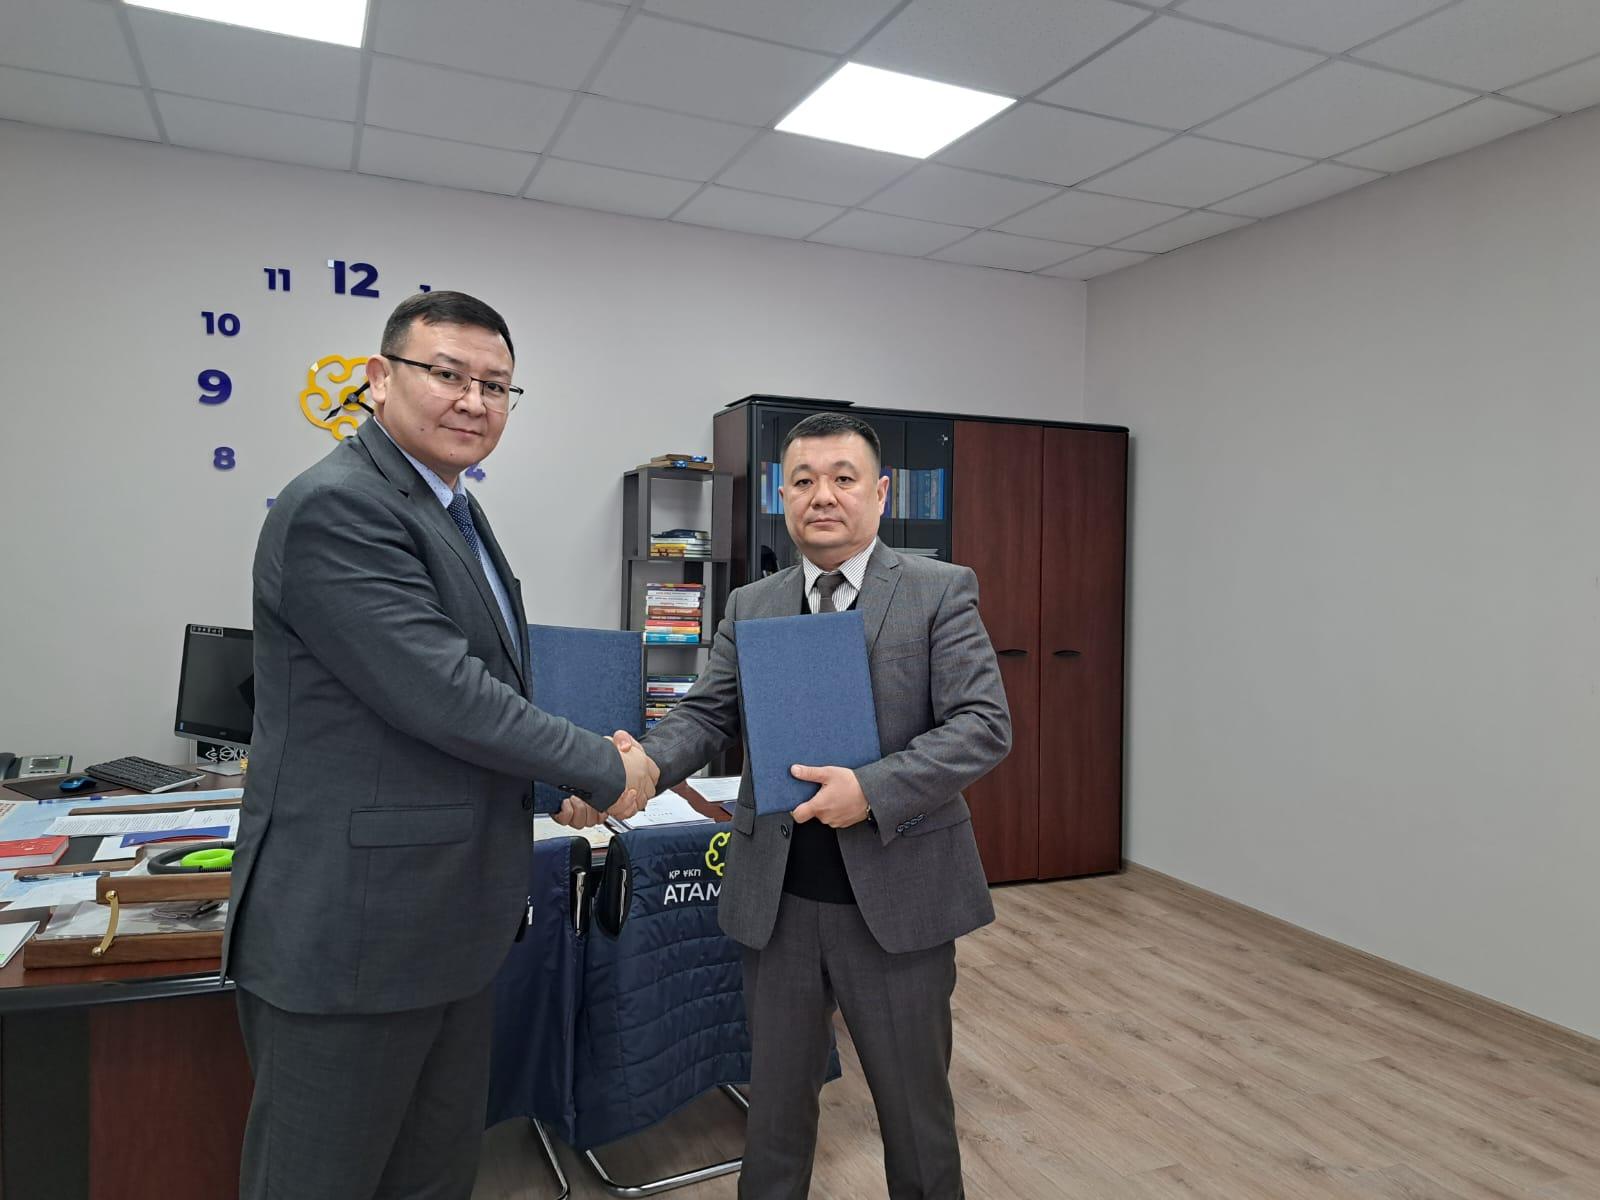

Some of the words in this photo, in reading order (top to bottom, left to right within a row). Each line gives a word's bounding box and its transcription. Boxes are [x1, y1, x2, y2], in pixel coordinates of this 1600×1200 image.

[264, 267, 291, 292] 11
[328, 259, 379, 298] 12
[201, 311, 241, 336] 10
[197, 369, 233, 405] 9
[213, 446, 236, 470] 8
